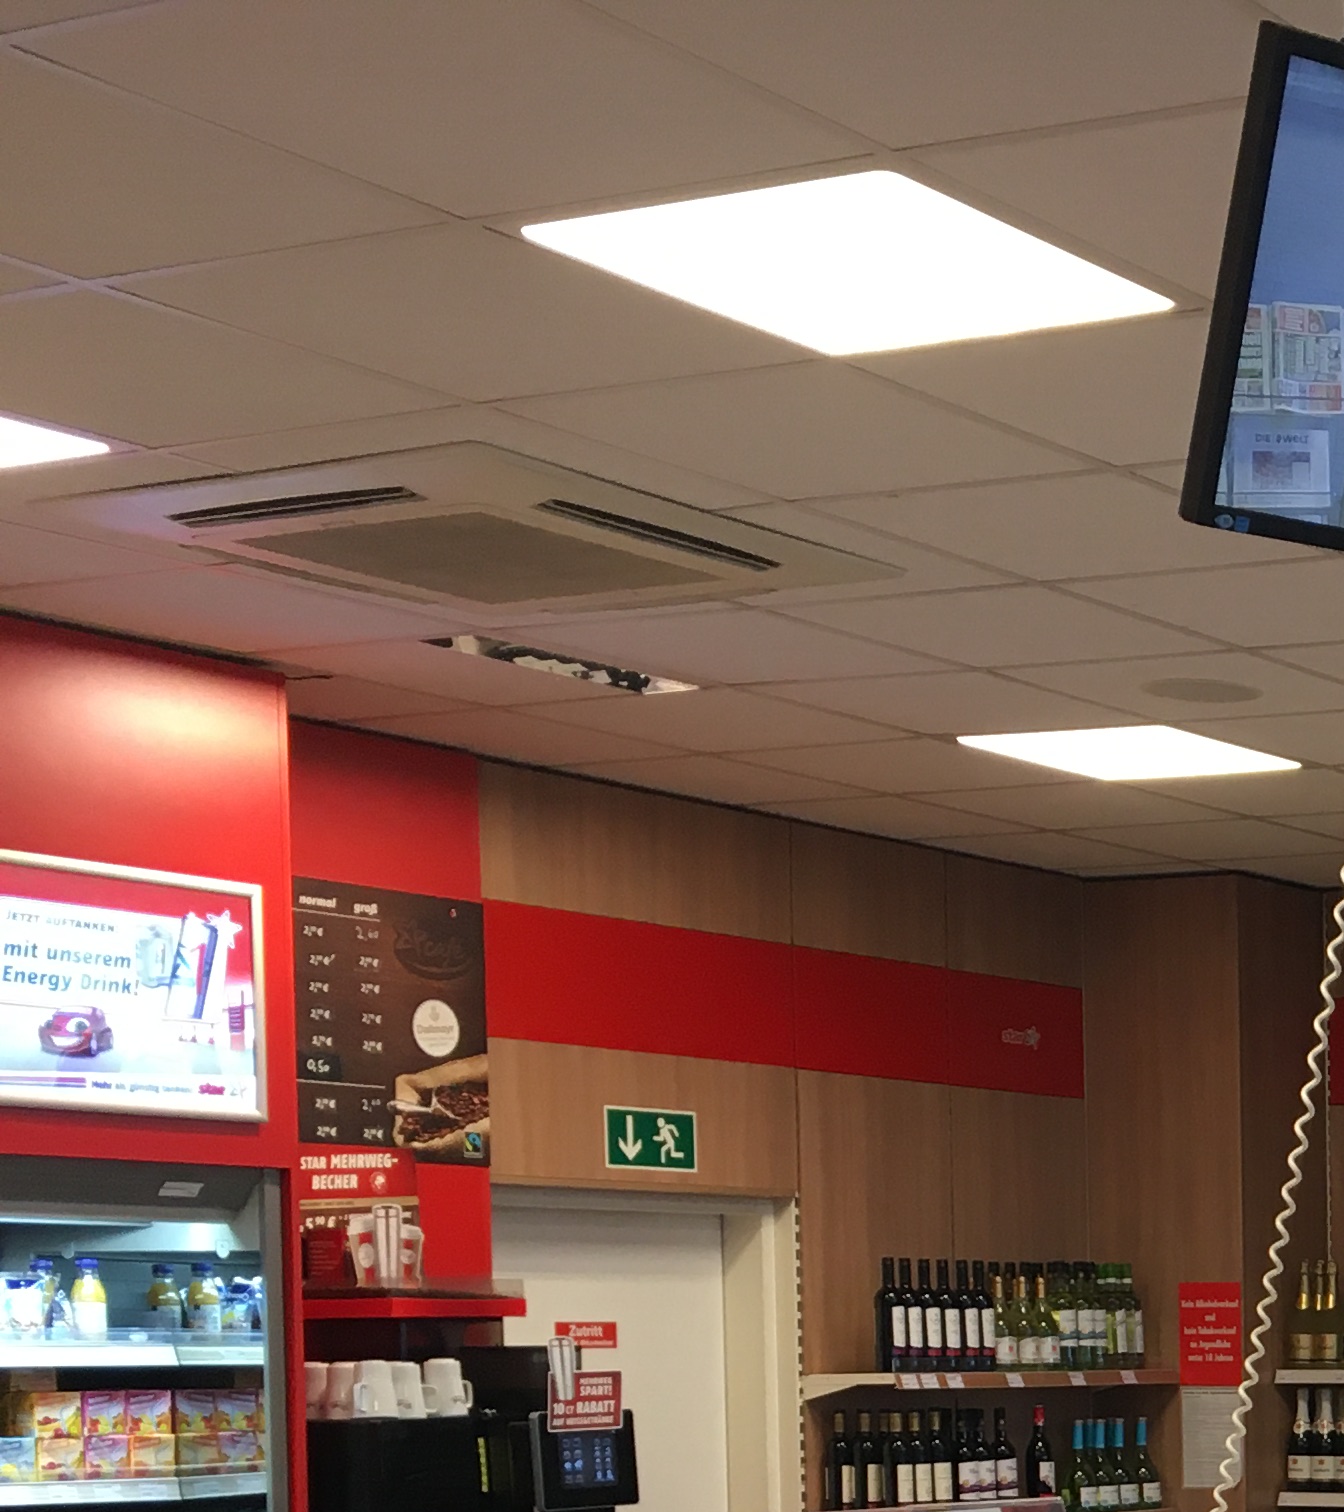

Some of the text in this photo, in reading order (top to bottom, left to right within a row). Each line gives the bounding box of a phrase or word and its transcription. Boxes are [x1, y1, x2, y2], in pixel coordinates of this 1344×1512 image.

[3, 941, 132, 969] mit unserem
[2, 965, 140, 996] Energy Drink!
[300, 1156, 327, 1170] STAR
[311, 1174, 358, 1190] BECHER
[568, 1325, 603, 1337] Zutritt
[580, 1385, 612, 1396] SPART!
[553, 1403, 565, 1415] 10
[576, 1401, 615, 1414] RABATT
